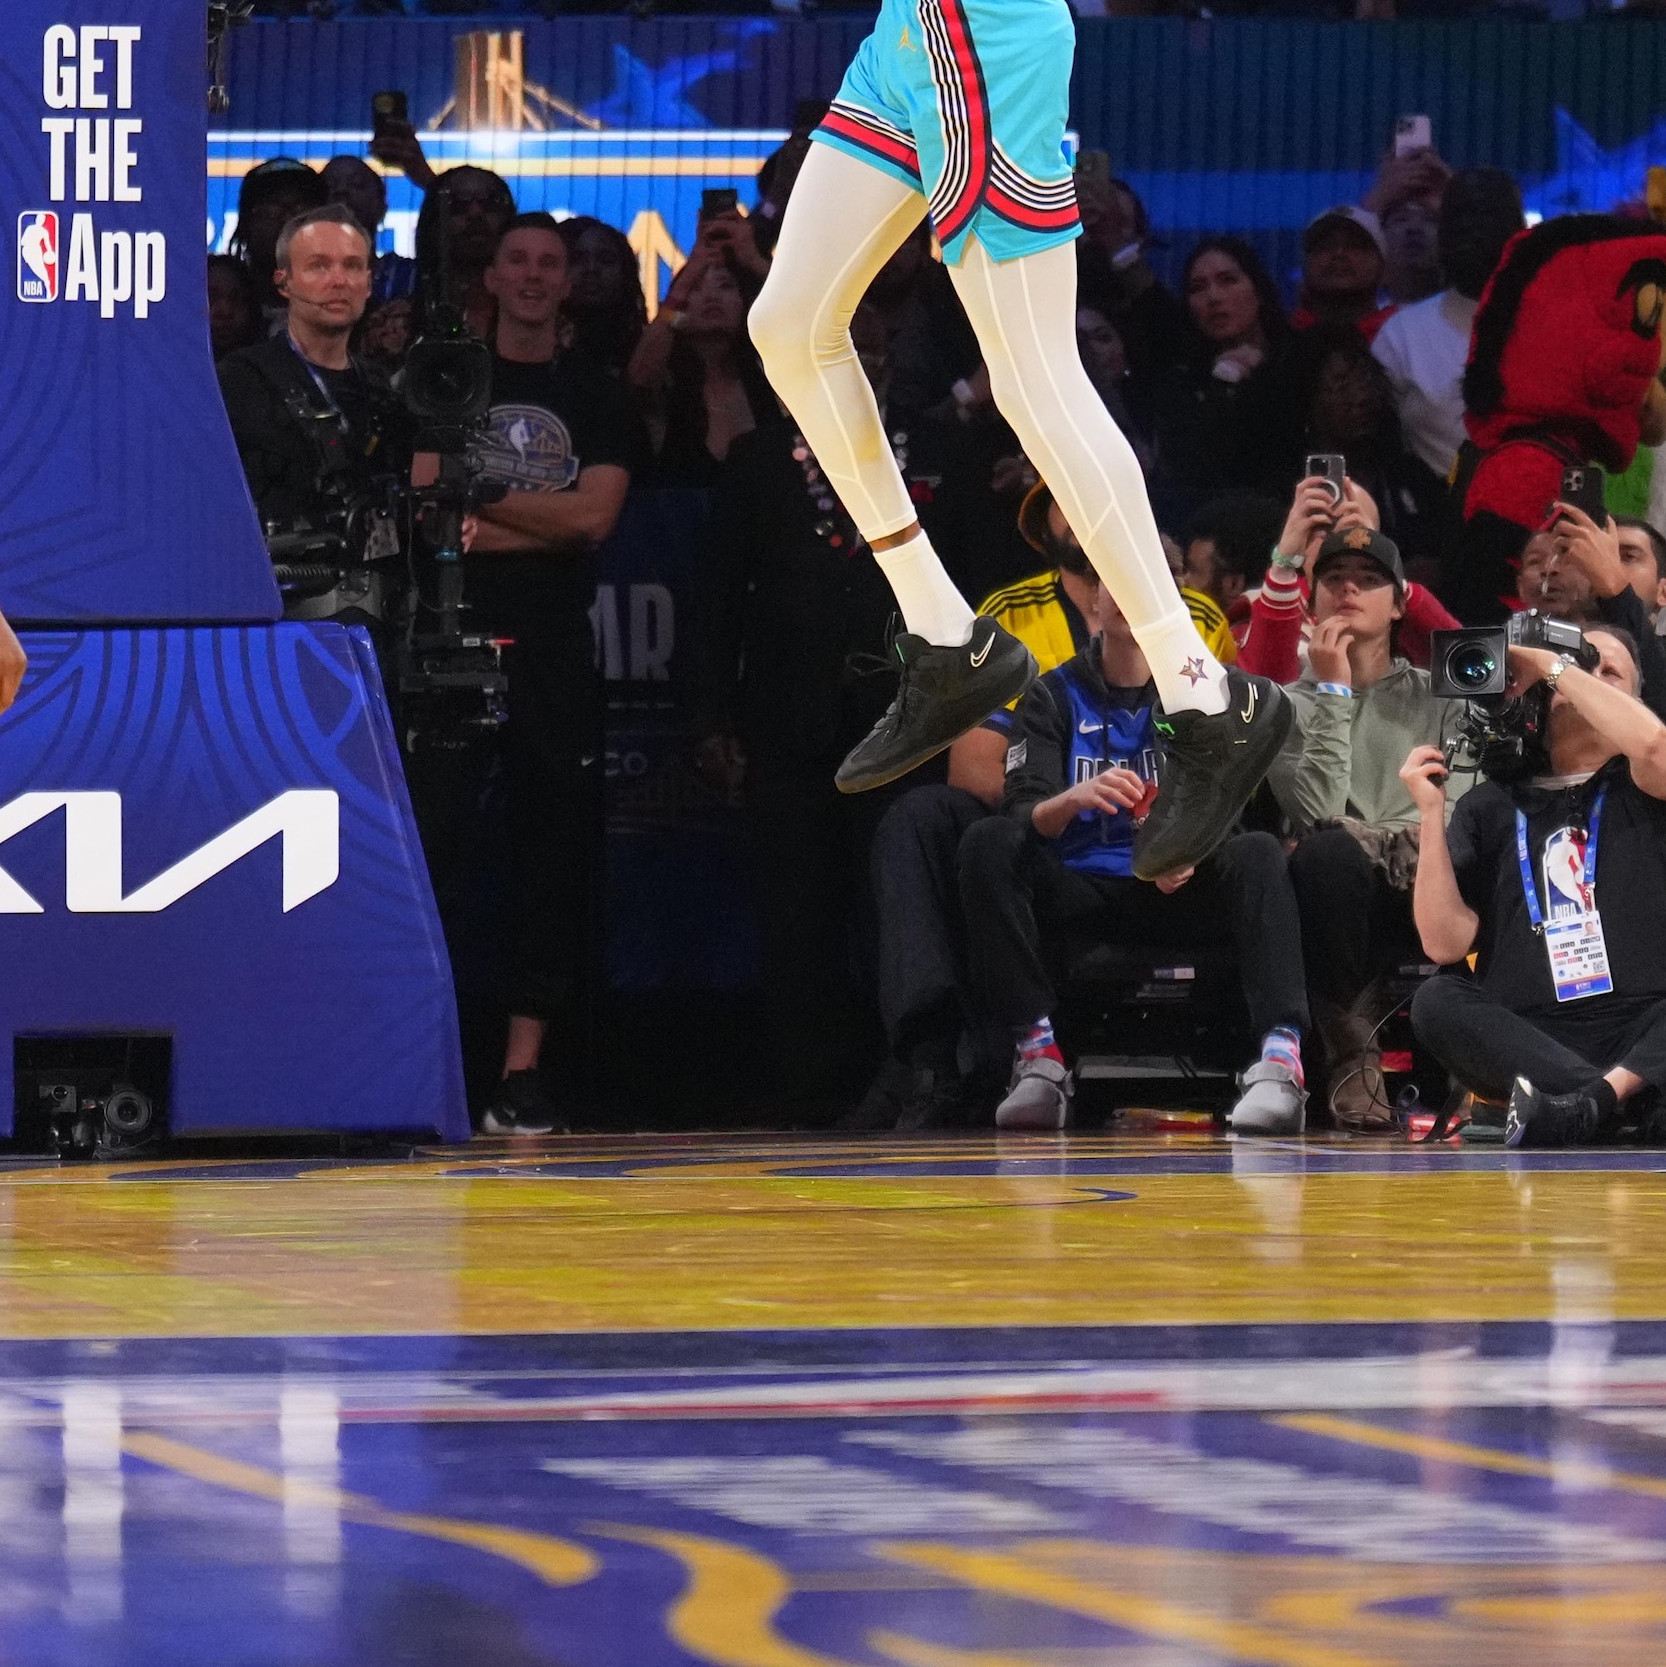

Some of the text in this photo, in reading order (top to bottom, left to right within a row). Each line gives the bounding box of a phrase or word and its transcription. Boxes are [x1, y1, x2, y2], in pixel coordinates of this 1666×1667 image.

[43, 24, 141, 109] GET
[41, 118, 142, 201] THE
[23, 280, 43, 296] NBA
[64, 212, 166, 319] App
[1554, 903, 1577, 920] NBA
